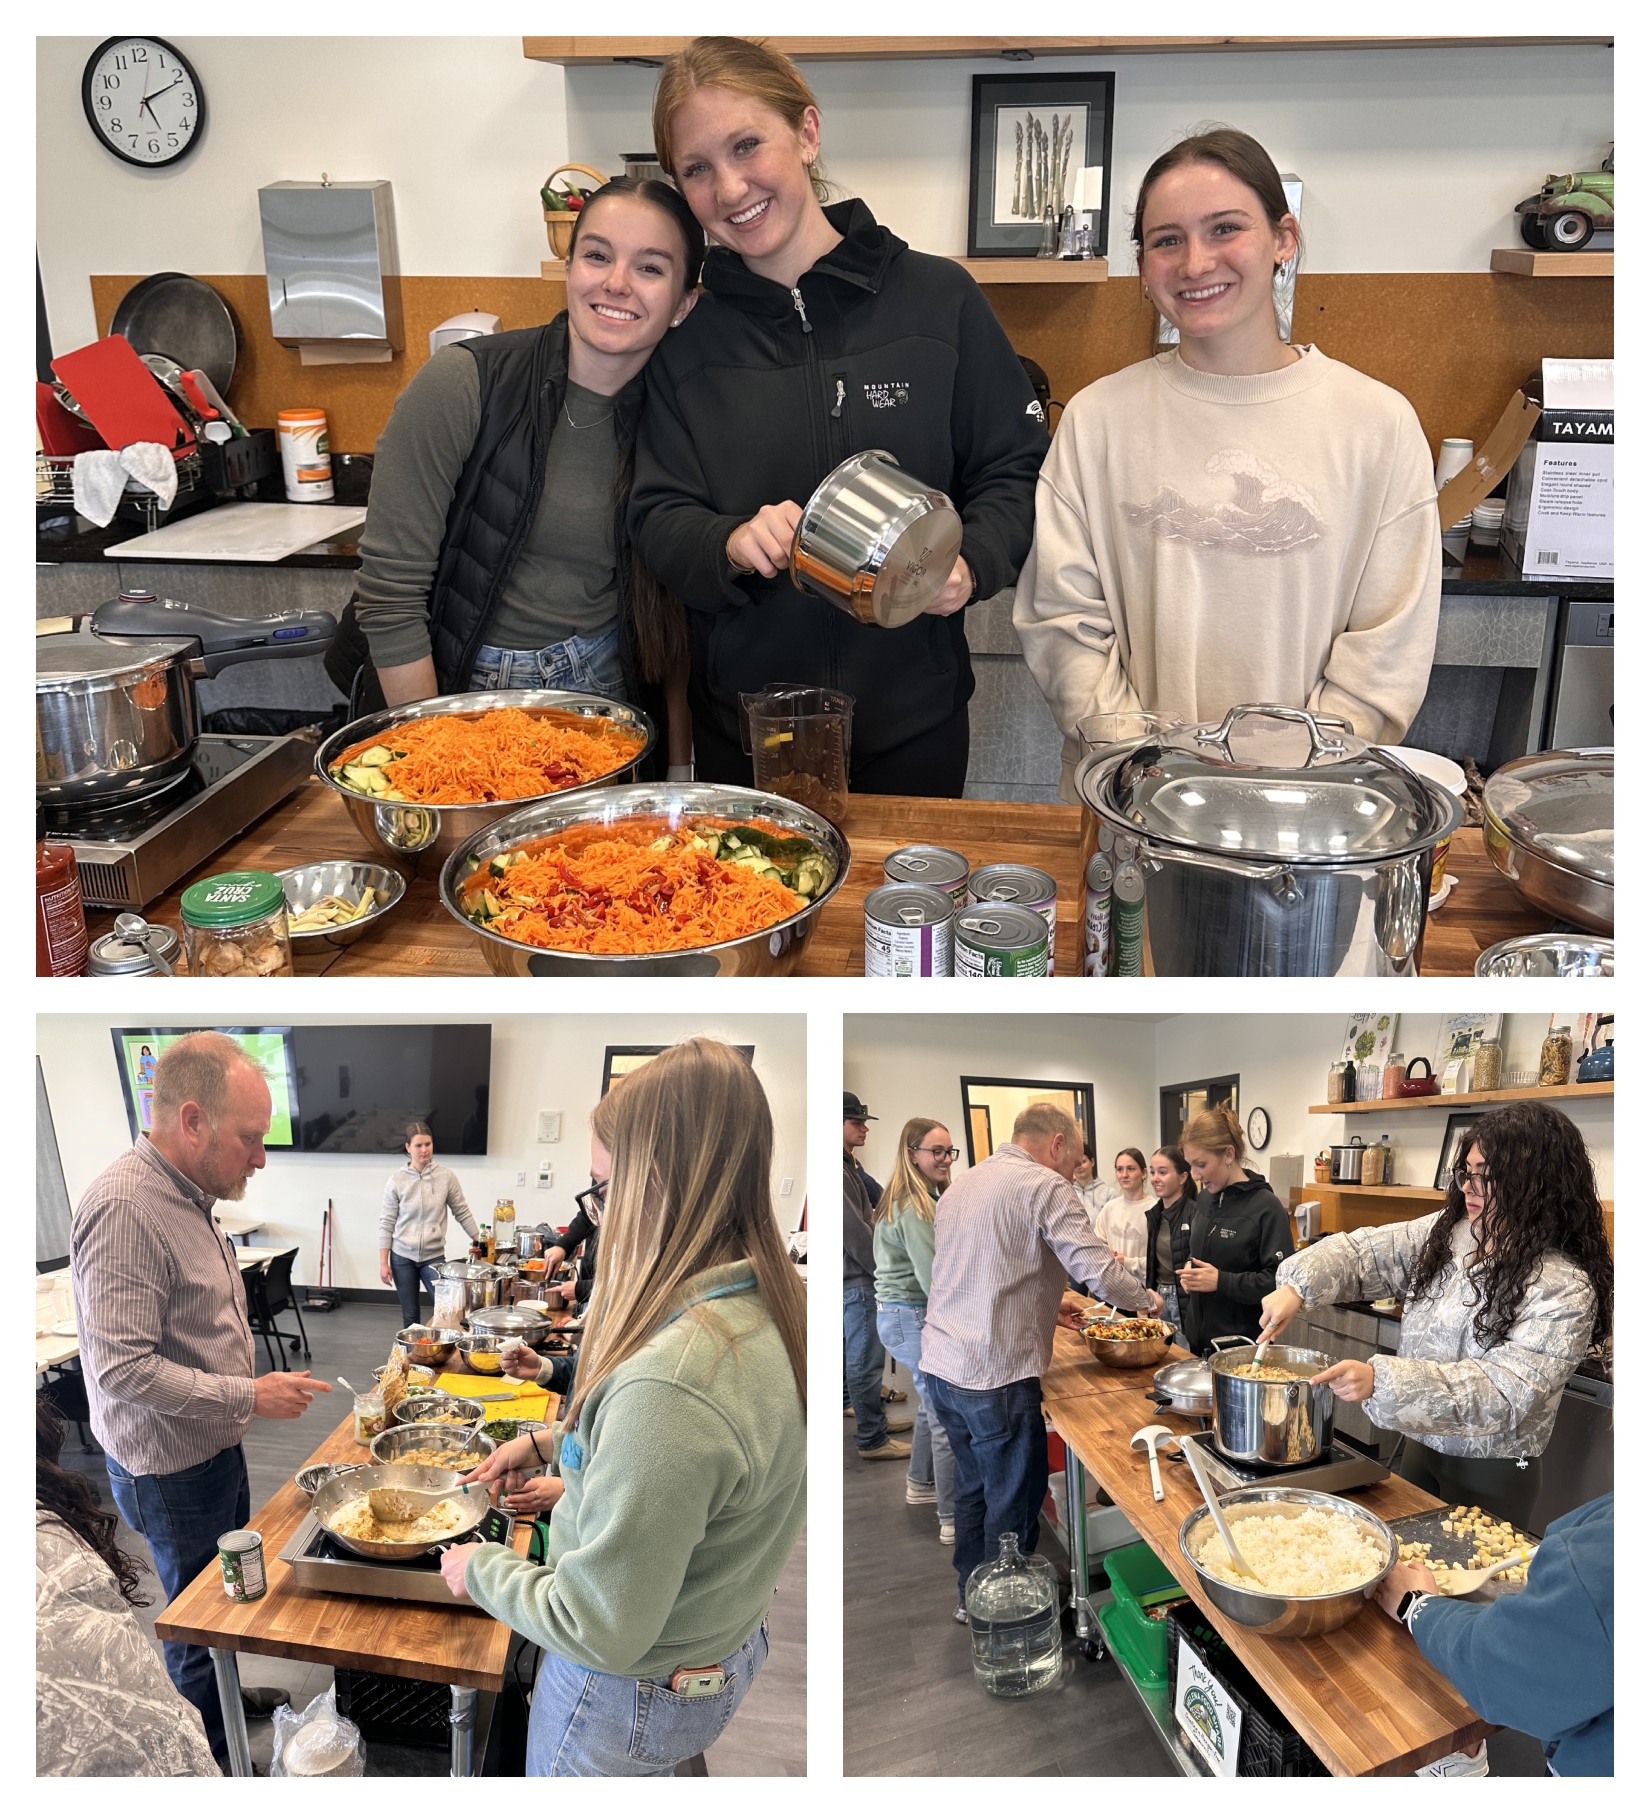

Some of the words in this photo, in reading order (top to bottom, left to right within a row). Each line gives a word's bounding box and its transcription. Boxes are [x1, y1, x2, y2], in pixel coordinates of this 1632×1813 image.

[132, 48, 147, 63] 12
[159, 54, 165, 68] 1
[116, 56, 128, 70] 11
[103, 74, 120, 89] 10
[172, 68, 183, 84] 2
[100, 96, 112, 110] 9
[182, 92, 194, 107] 3
[111, 118, 122, 133] 8
[179, 116, 191, 130] 4
[128, 134, 138, 148] 7
[148, 139, 160, 153] 6
[168, 133, 179, 147] 5
[866, 390, 889, 400] HARD
[872, 398, 896, 408] WEAR
[1553, 422, 1614, 436] TAYAM
[906, 560, 926, 578] VIGOR
[205, 893, 250, 902] SANTA
[214, 886, 253, 895] CRUZ
[881, 944, 891, 954] 45
[968, 949, 983, 959] Facts
